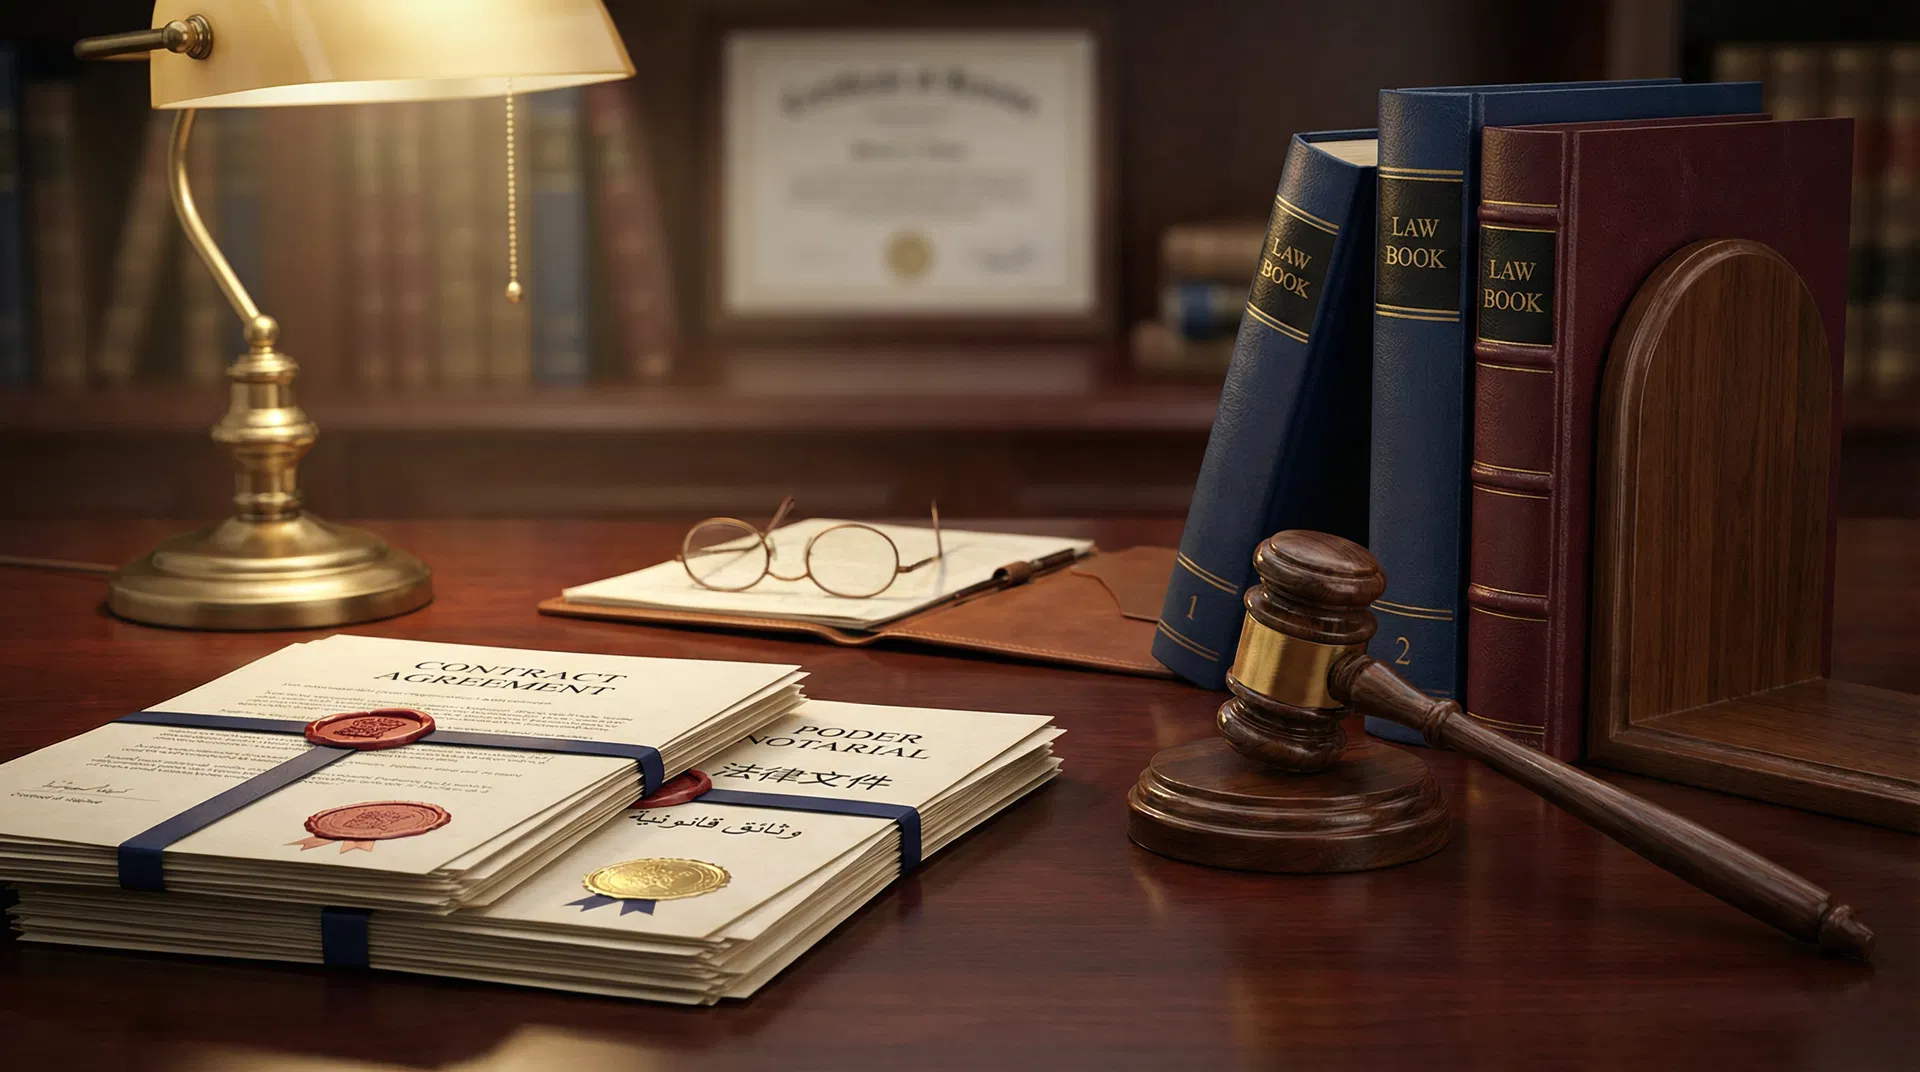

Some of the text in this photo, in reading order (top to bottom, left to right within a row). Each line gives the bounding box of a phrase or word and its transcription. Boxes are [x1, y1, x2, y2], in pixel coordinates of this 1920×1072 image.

[1391, 216, 1440, 238] LAW
[1271, 237, 1312, 270] LAW
[1385, 245, 1447, 269] BOOK
[1261, 258, 1311, 299] BOOK
[1488, 259, 1537, 281] LAW
[1483, 289, 1544, 313] BOOK
[1186, 595, 1199, 621] 1
[1395, 636, 1411, 665] 2
[374, 671, 616, 696] AGREEMENT
[414, 661, 628, 684] CONTRACT
[792, 725, 923, 744] PODER
[738, 735, 931, 760] NOTARIAL
[711, 762, 893, 791] 法律文件
[629, 810, 803, 840] وثائق قانونية
